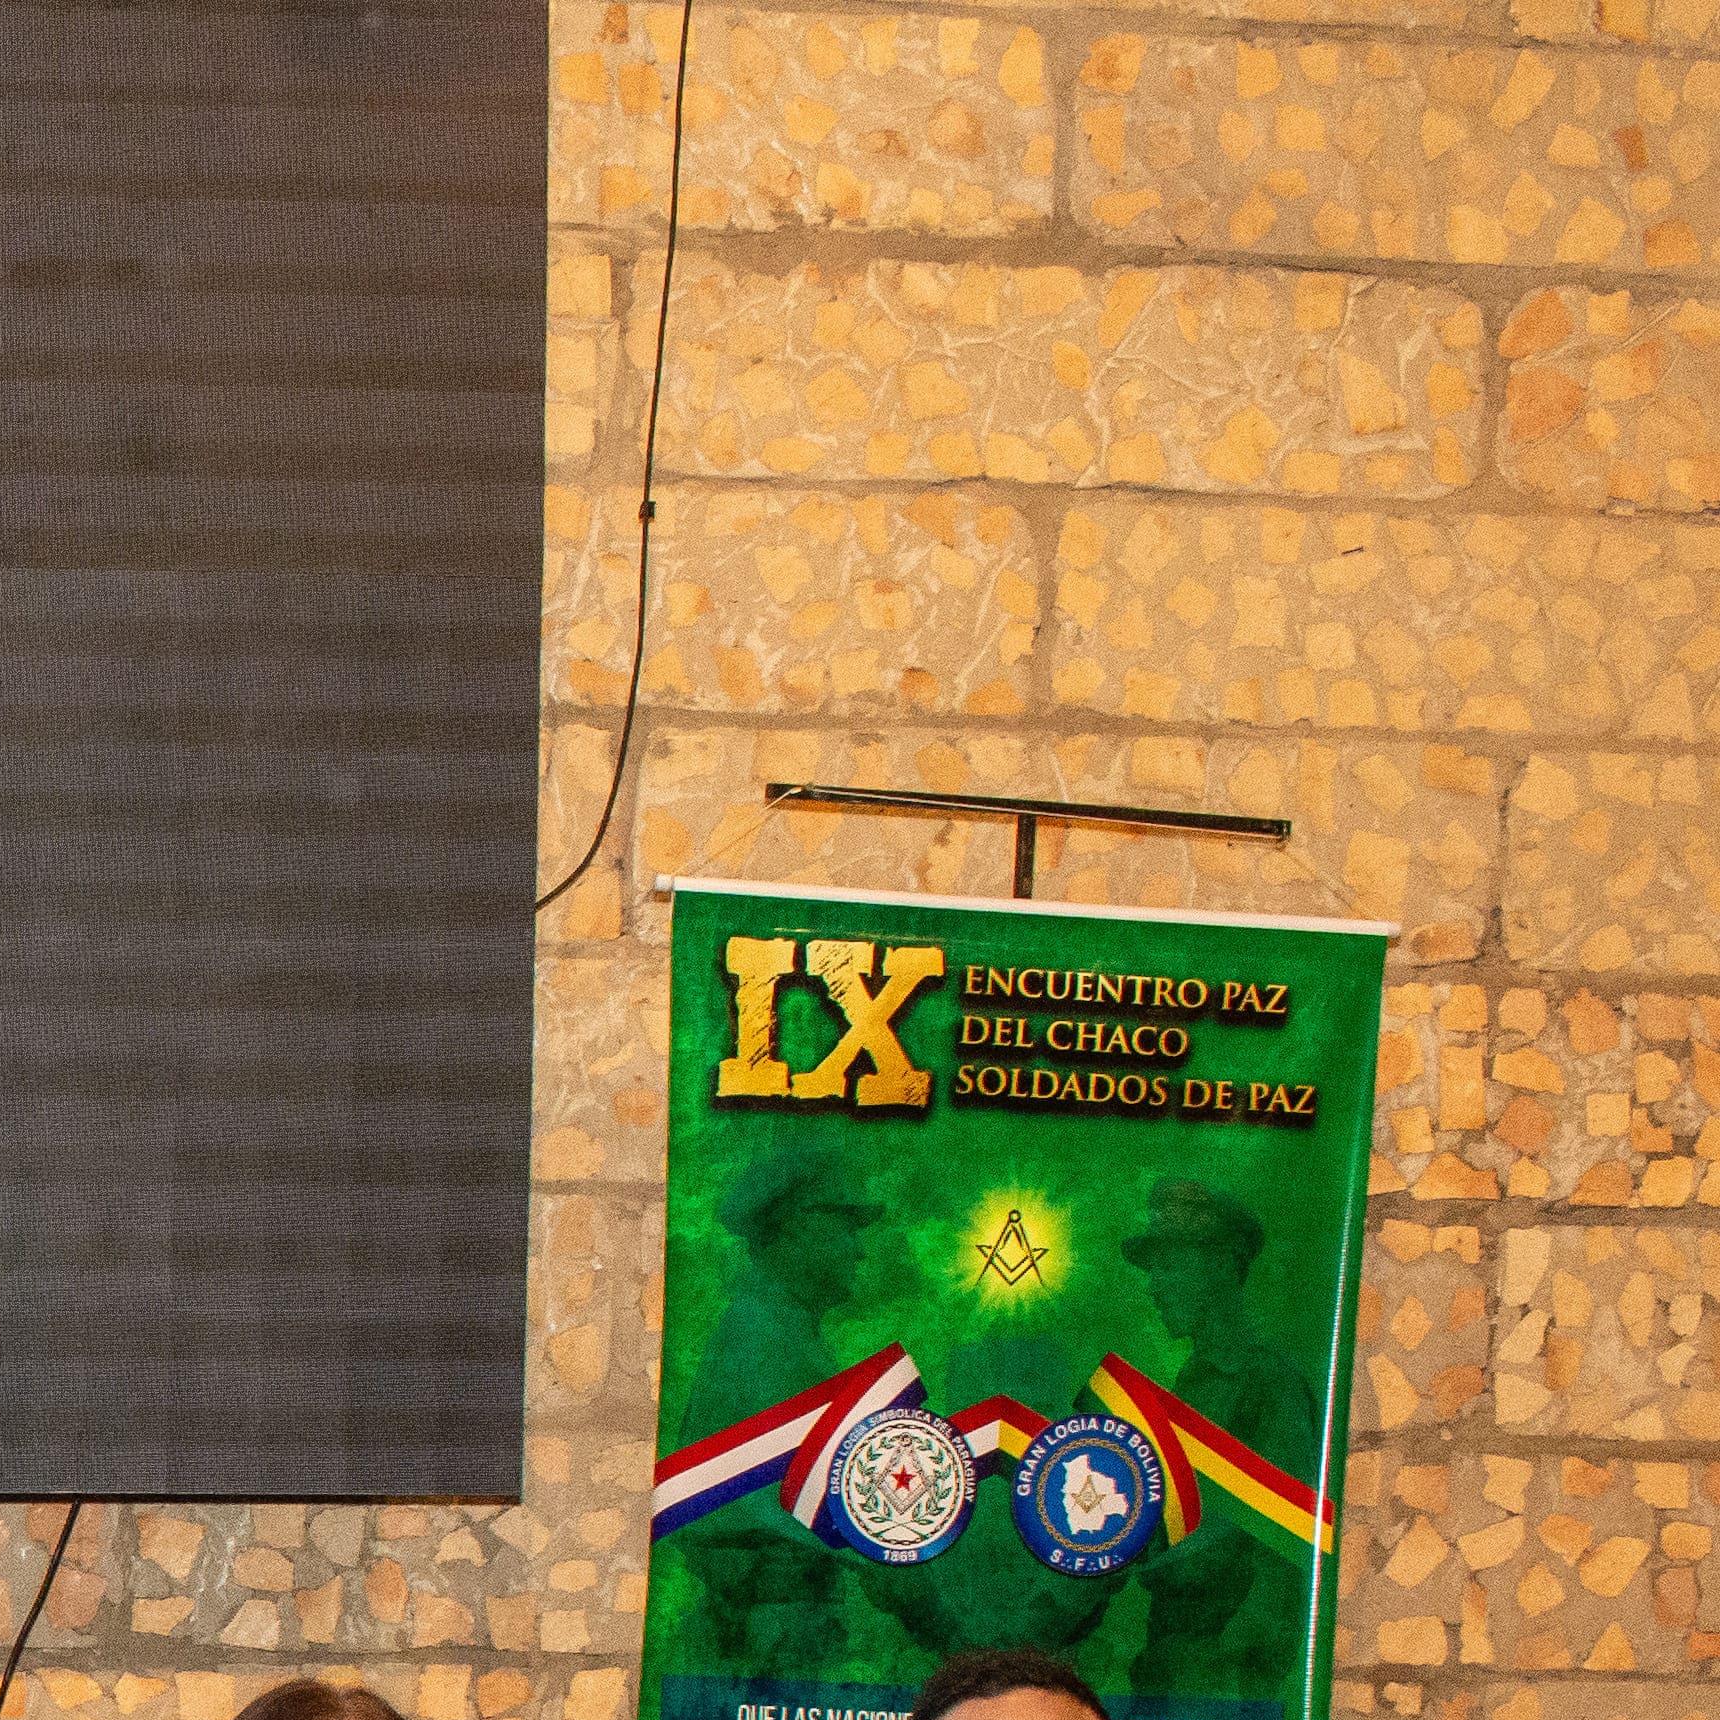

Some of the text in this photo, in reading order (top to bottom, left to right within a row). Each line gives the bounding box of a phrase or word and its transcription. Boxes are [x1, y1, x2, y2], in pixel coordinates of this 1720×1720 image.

[964, 965, 1289, 1014] ENCUENTRO PAZ
[716, 936, 946, 1108] IX
[960, 1014, 1191, 1058] DEL CHACO
[955, 1064, 1316, 1115] SOLDADOS DE PAZ
[1016, 1417, 1162, 1504] GRAN LOGIA DE BOLIVIA
